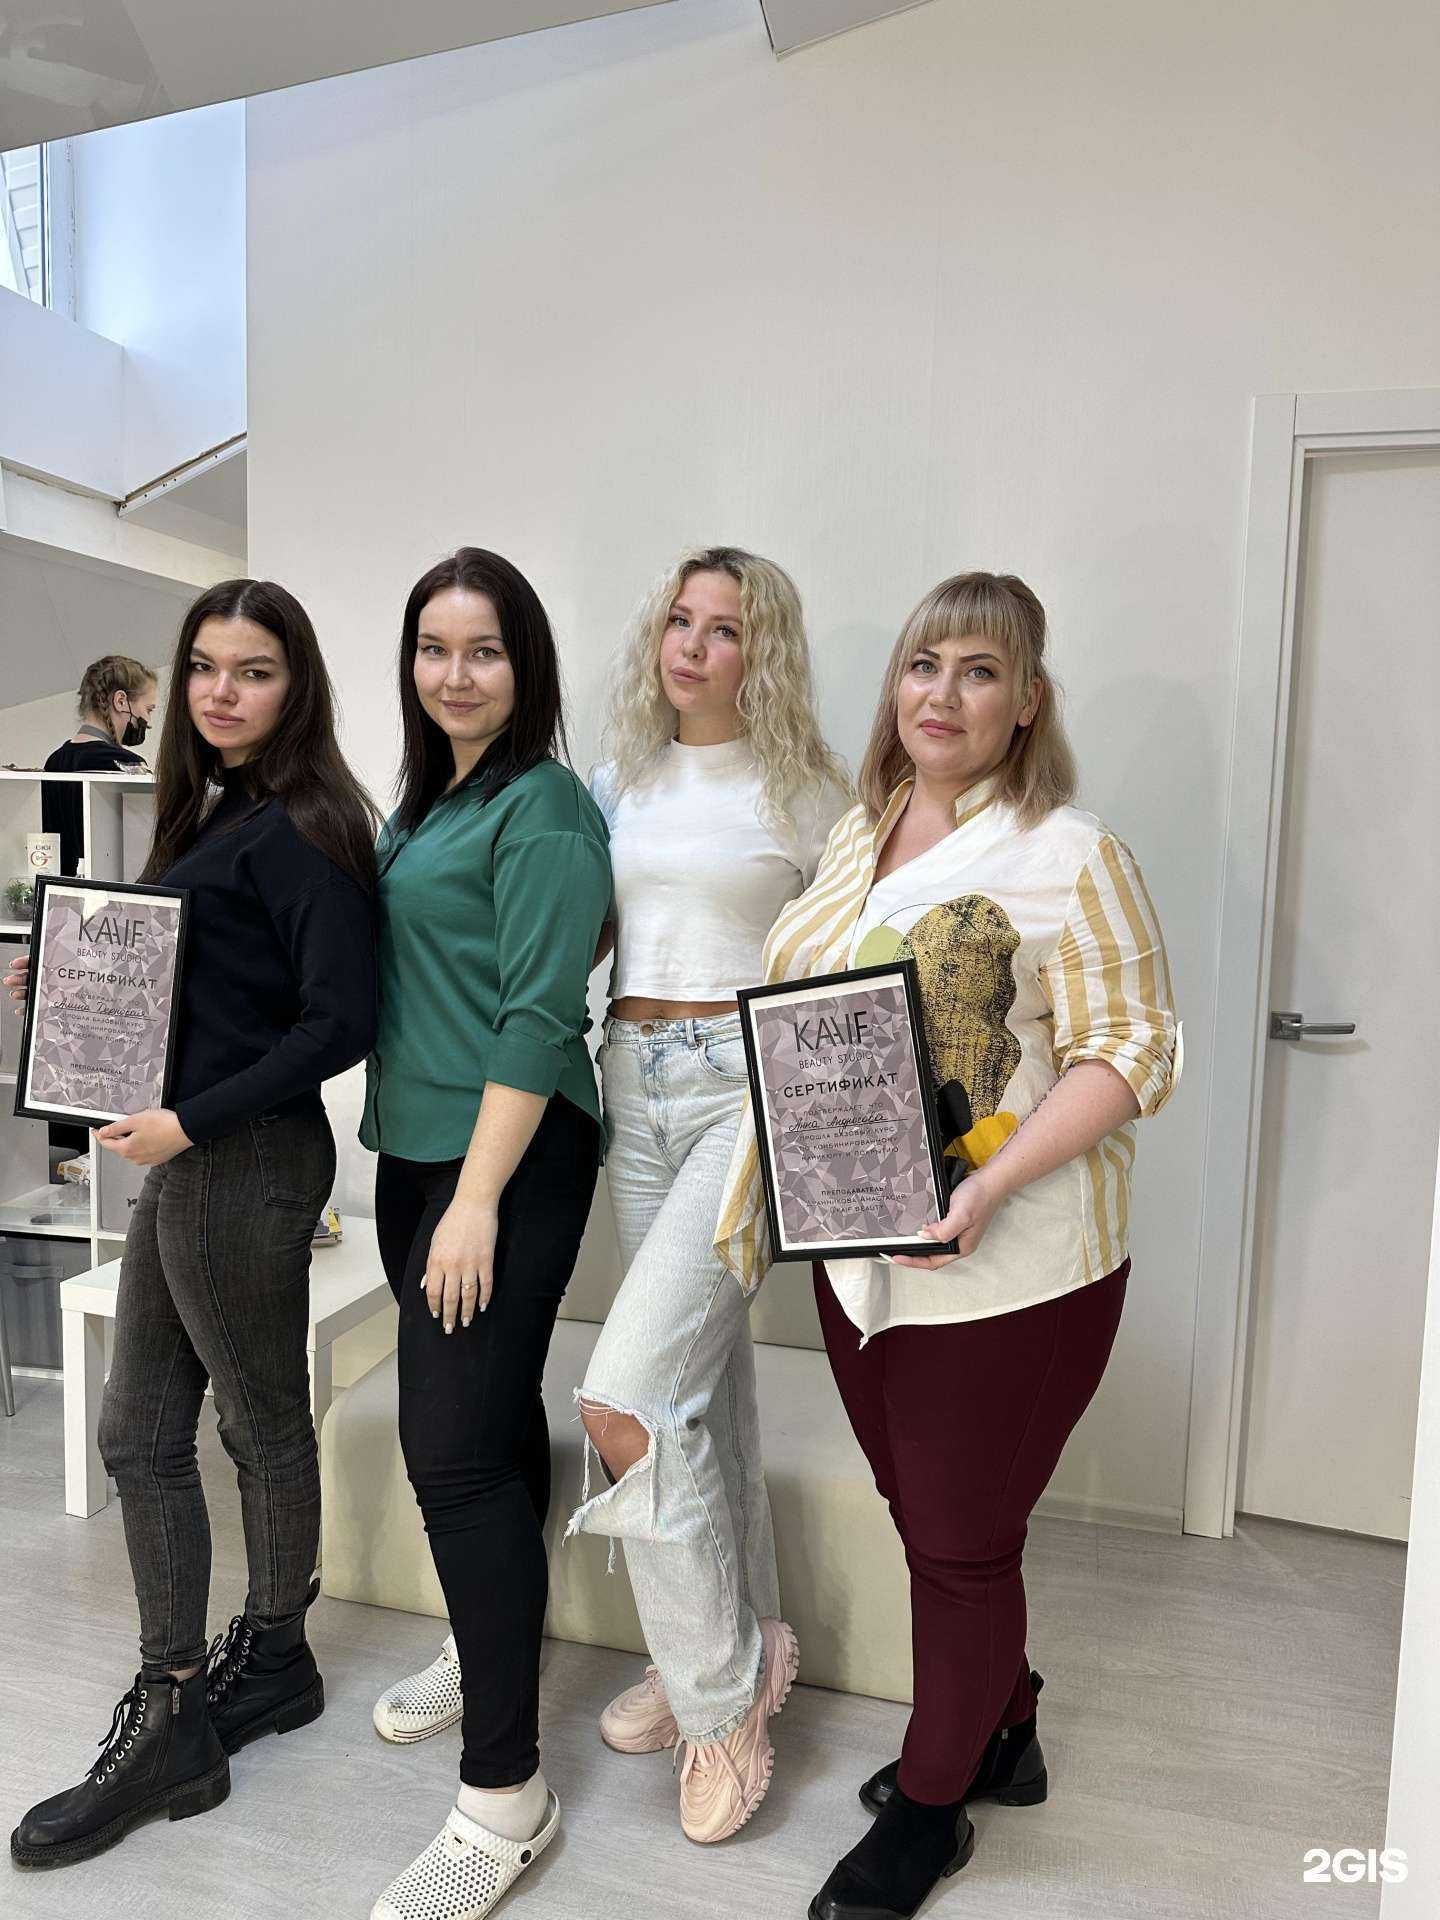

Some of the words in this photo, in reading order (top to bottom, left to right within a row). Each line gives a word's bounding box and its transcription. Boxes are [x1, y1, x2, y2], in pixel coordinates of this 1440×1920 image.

[77, 948, 106, 960] BEAUTY
[111, 952, 142, 964] STUDIO
[58, 967, 158, 990] СЕРТИФИКАТ
[799, 1056, 833, 1070] BEAUTY
[838, 1050, 874, 1064] STUDIO
[783, 1072, 898, 1099] СЕРТИФИКАТ
[799, 1133, 831, 1141] ПРОШЛА
[834, 1129, 872, 1138] БАЗОВЫЙ
[874, 1126, 896, 1134] КУРС
